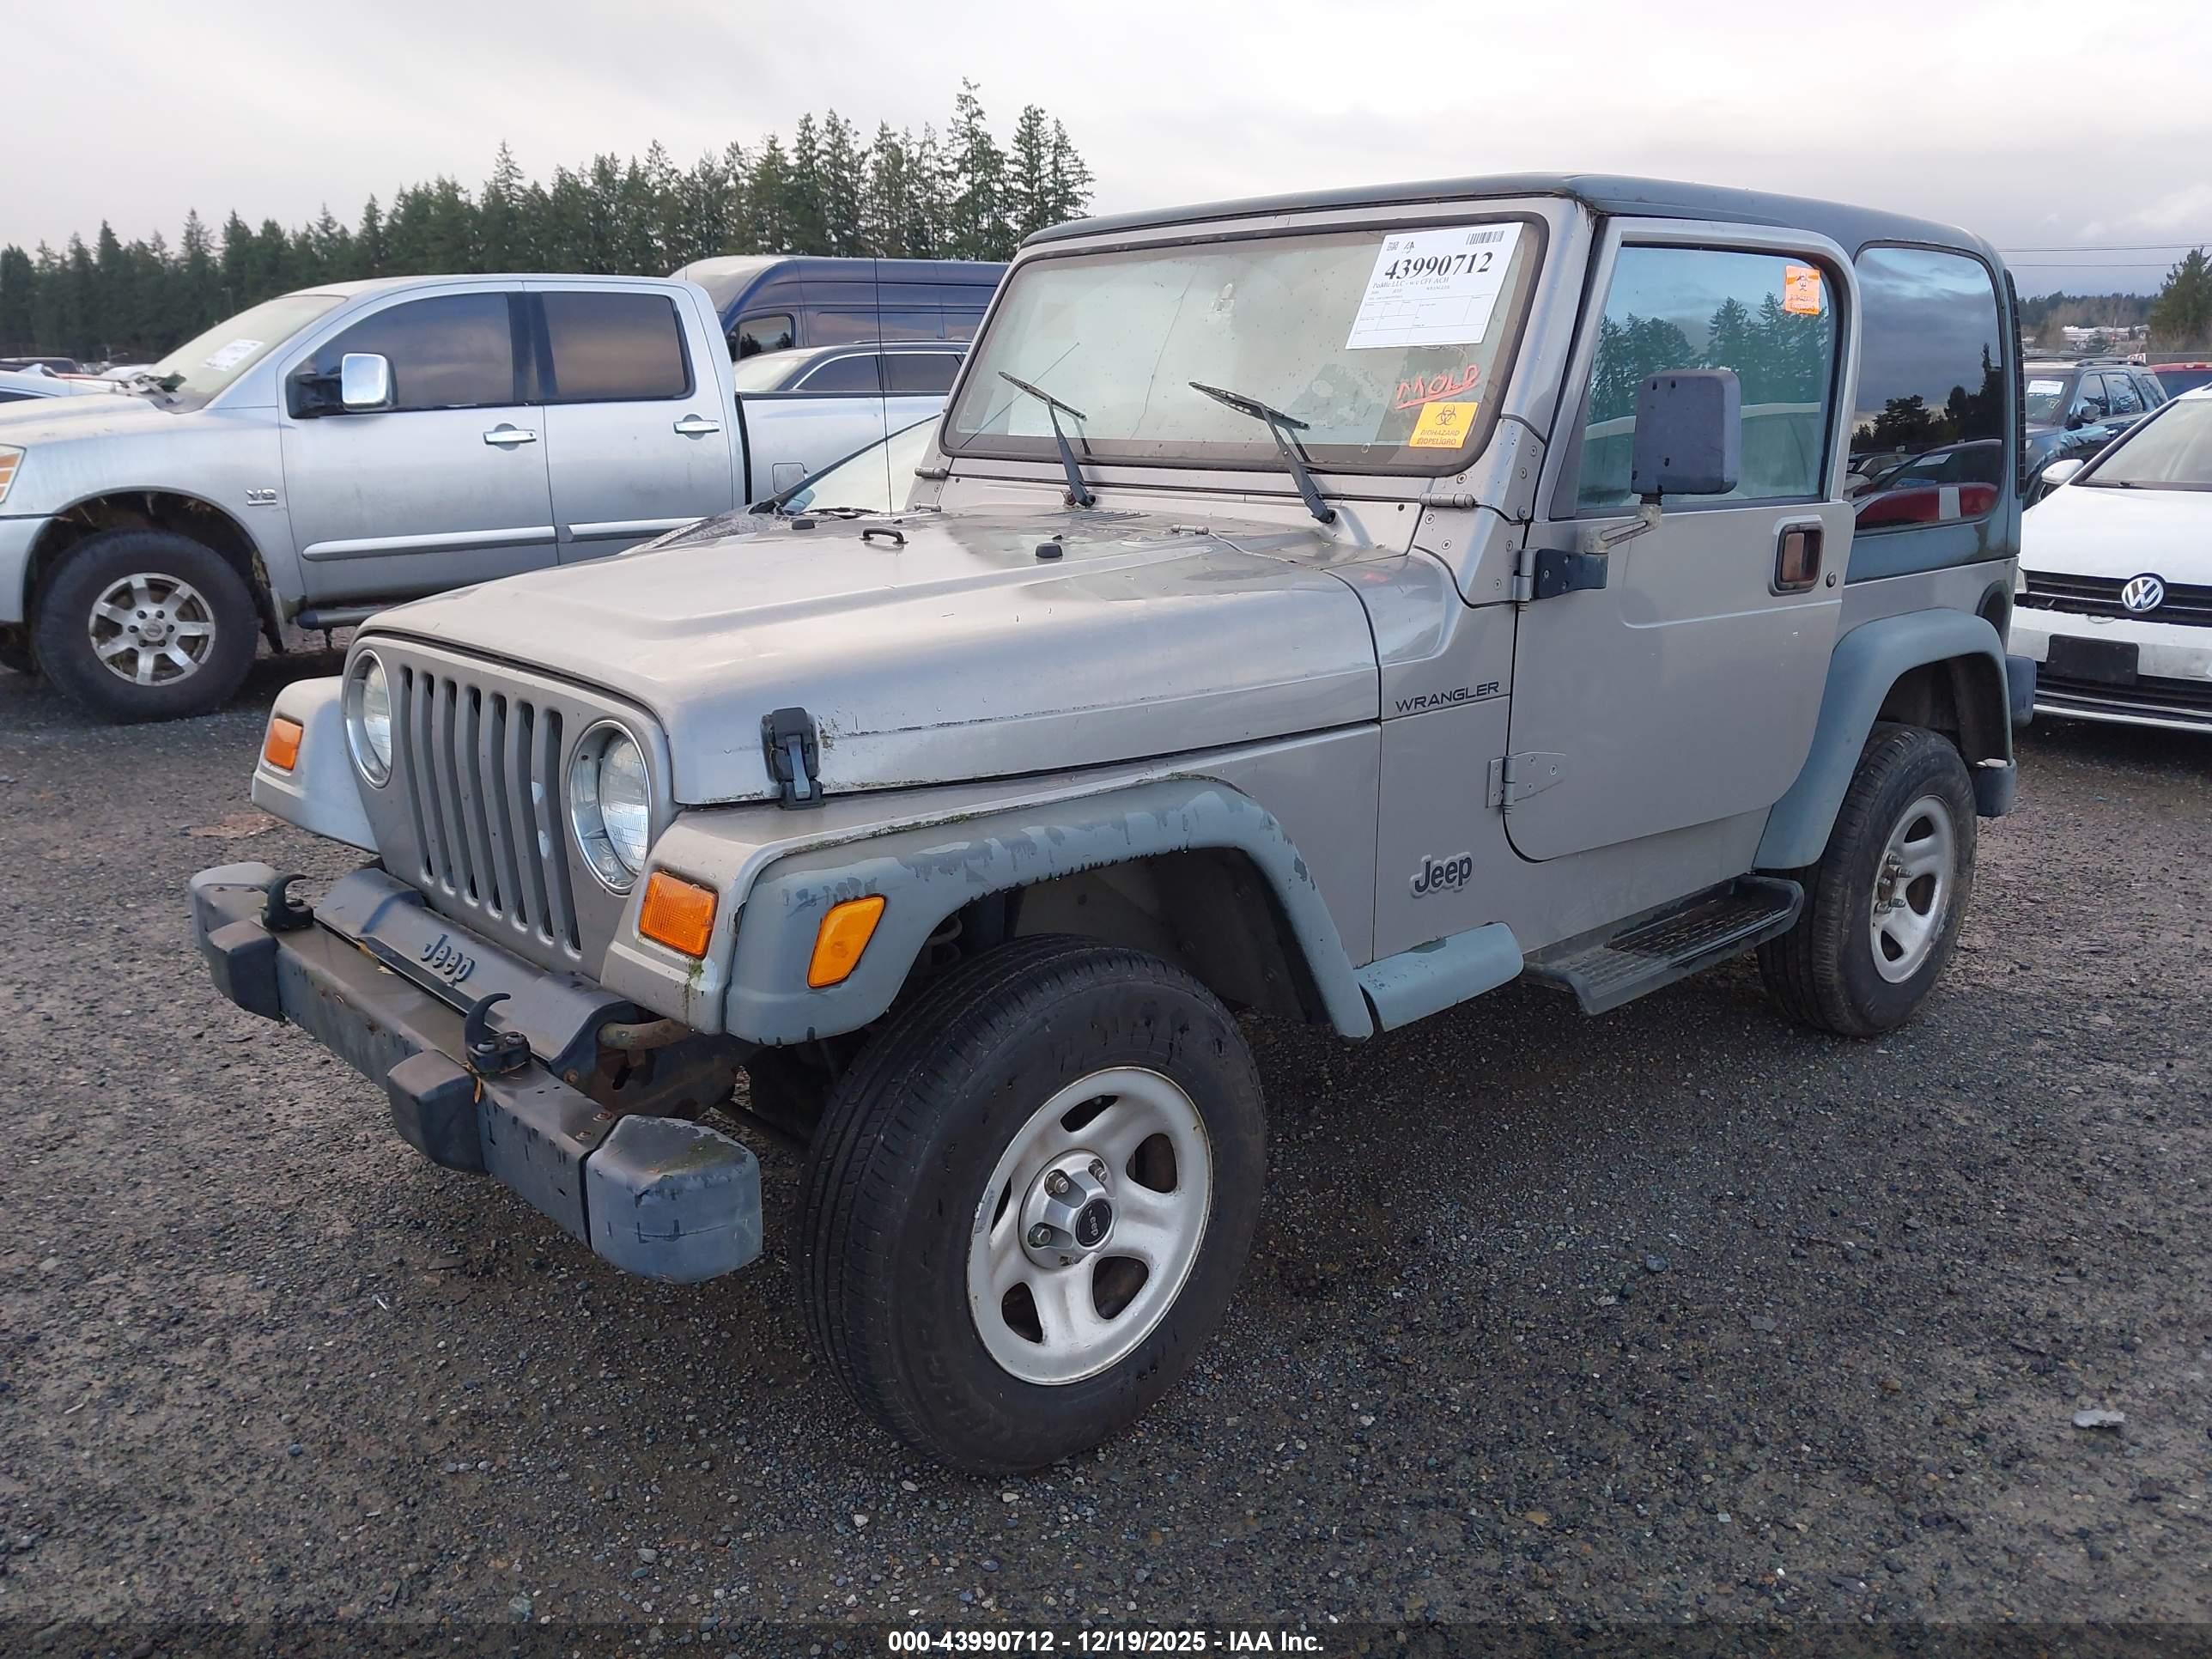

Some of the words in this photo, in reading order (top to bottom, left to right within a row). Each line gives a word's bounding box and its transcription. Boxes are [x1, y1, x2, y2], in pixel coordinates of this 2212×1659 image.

[1384, 251, 1494, 281] 43990712
[1395, 363, 1480, 401] MOLD
[1395, 681, 1499, 713] WRANGLER
[1412, 854, 1473, 895] Jeep
[419, 933, 476, 988] Jeep
